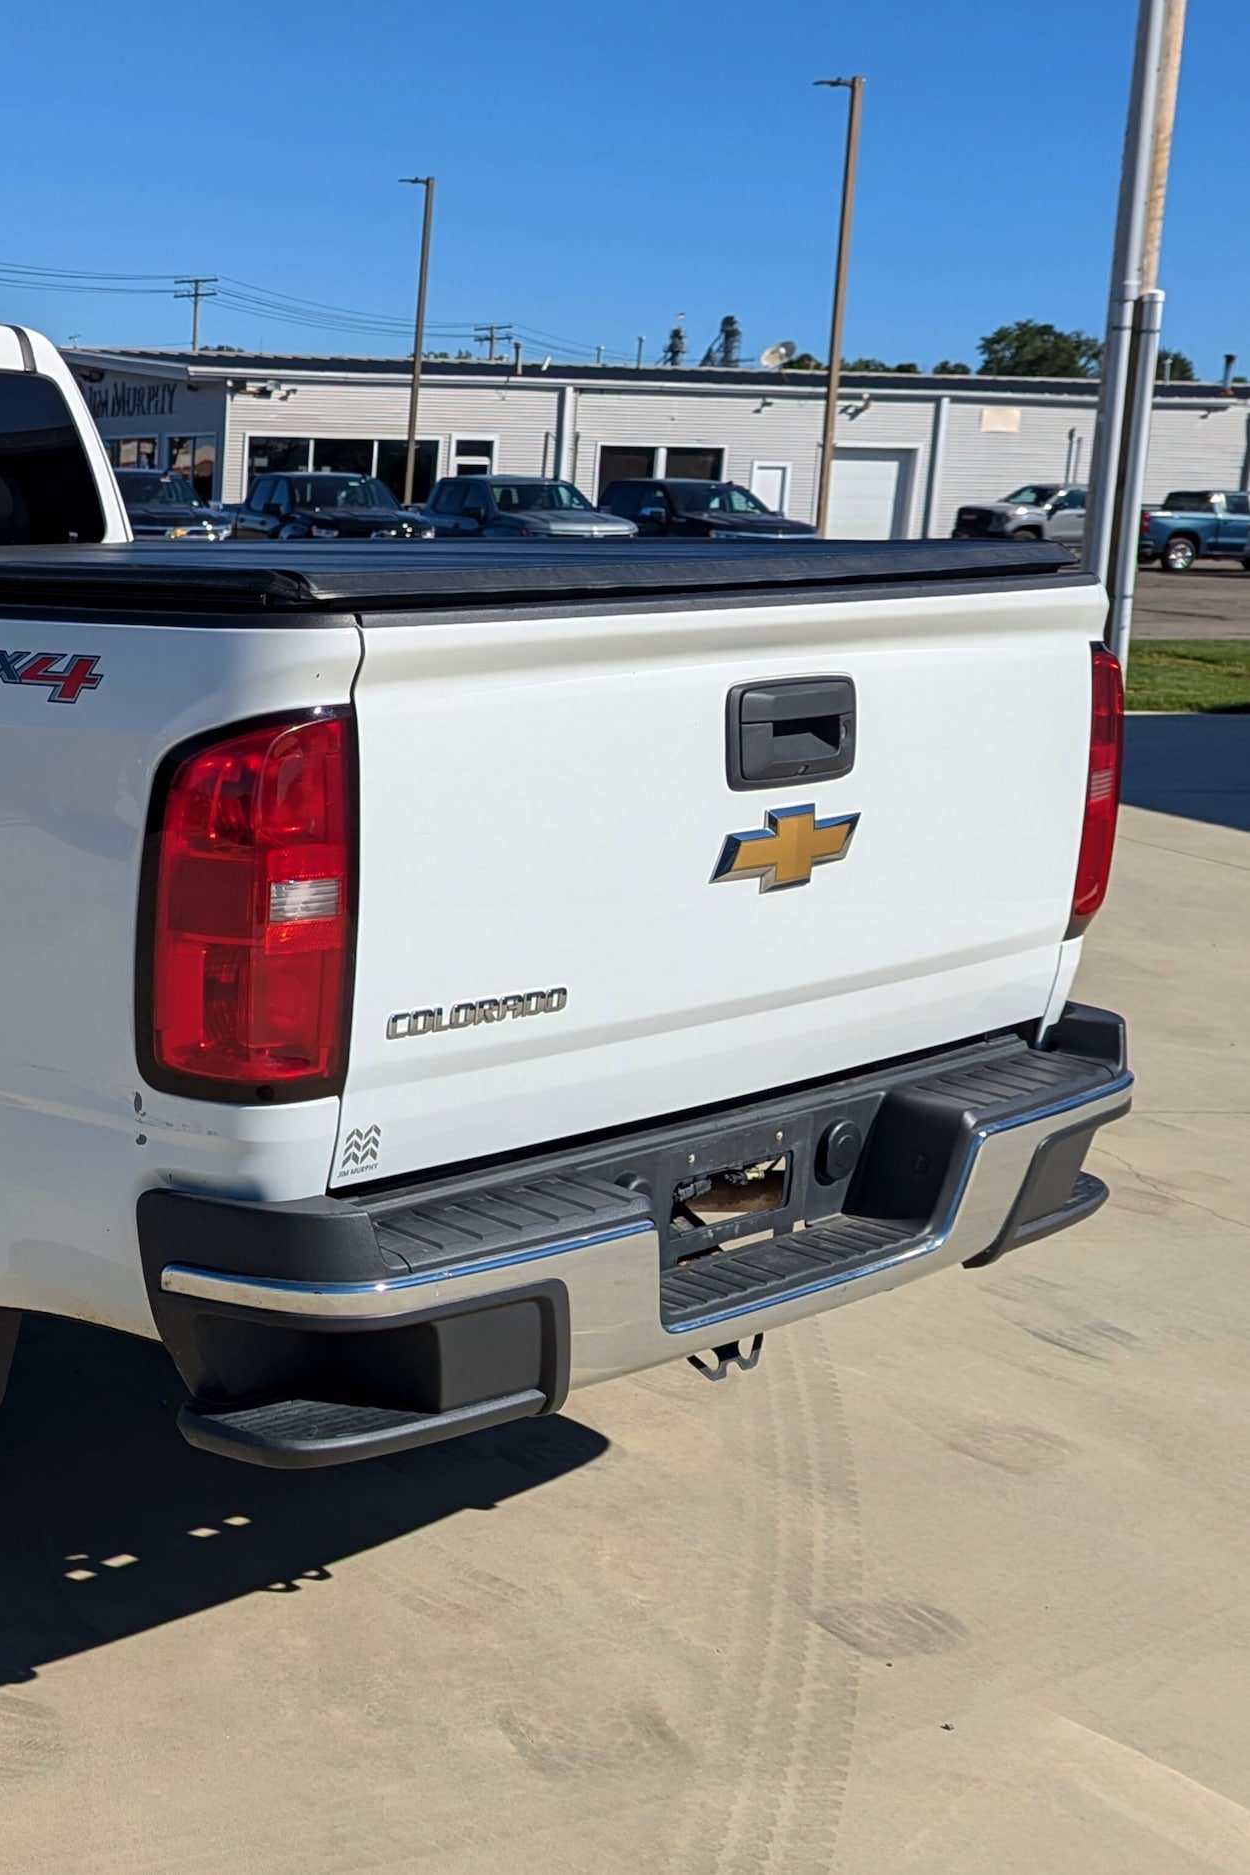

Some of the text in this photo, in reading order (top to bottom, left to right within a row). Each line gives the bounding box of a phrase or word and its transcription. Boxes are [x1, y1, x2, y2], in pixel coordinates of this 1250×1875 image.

[110, 381, 178, 417] MURPHY
[385, 986, 568, 1041] COLORADO
[337, 1162, 380, 1179] JIM MURPHY
